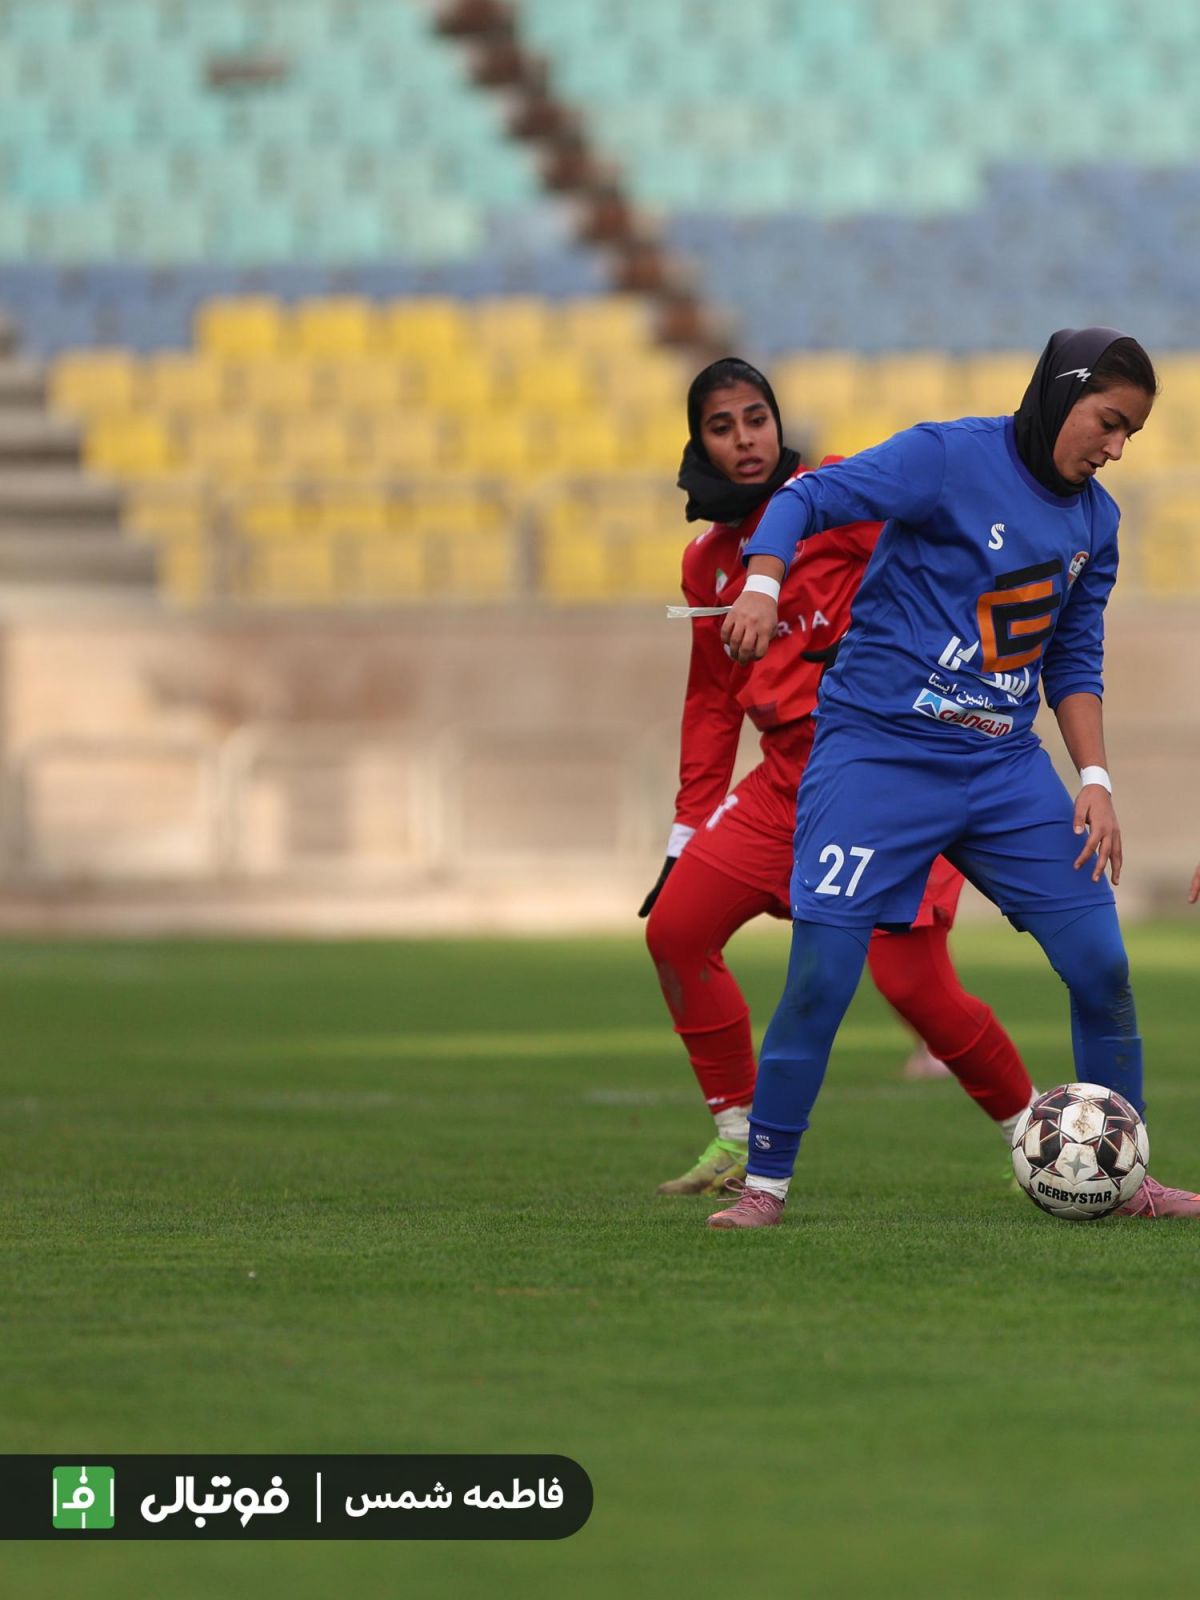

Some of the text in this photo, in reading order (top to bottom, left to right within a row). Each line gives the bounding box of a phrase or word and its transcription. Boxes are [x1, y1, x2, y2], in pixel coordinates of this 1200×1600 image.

[775, 610, 830, 638] RIA
[814, 844, 875, 897] 27
[1037, 1181, 1112, 1204] DERBYSTAR
